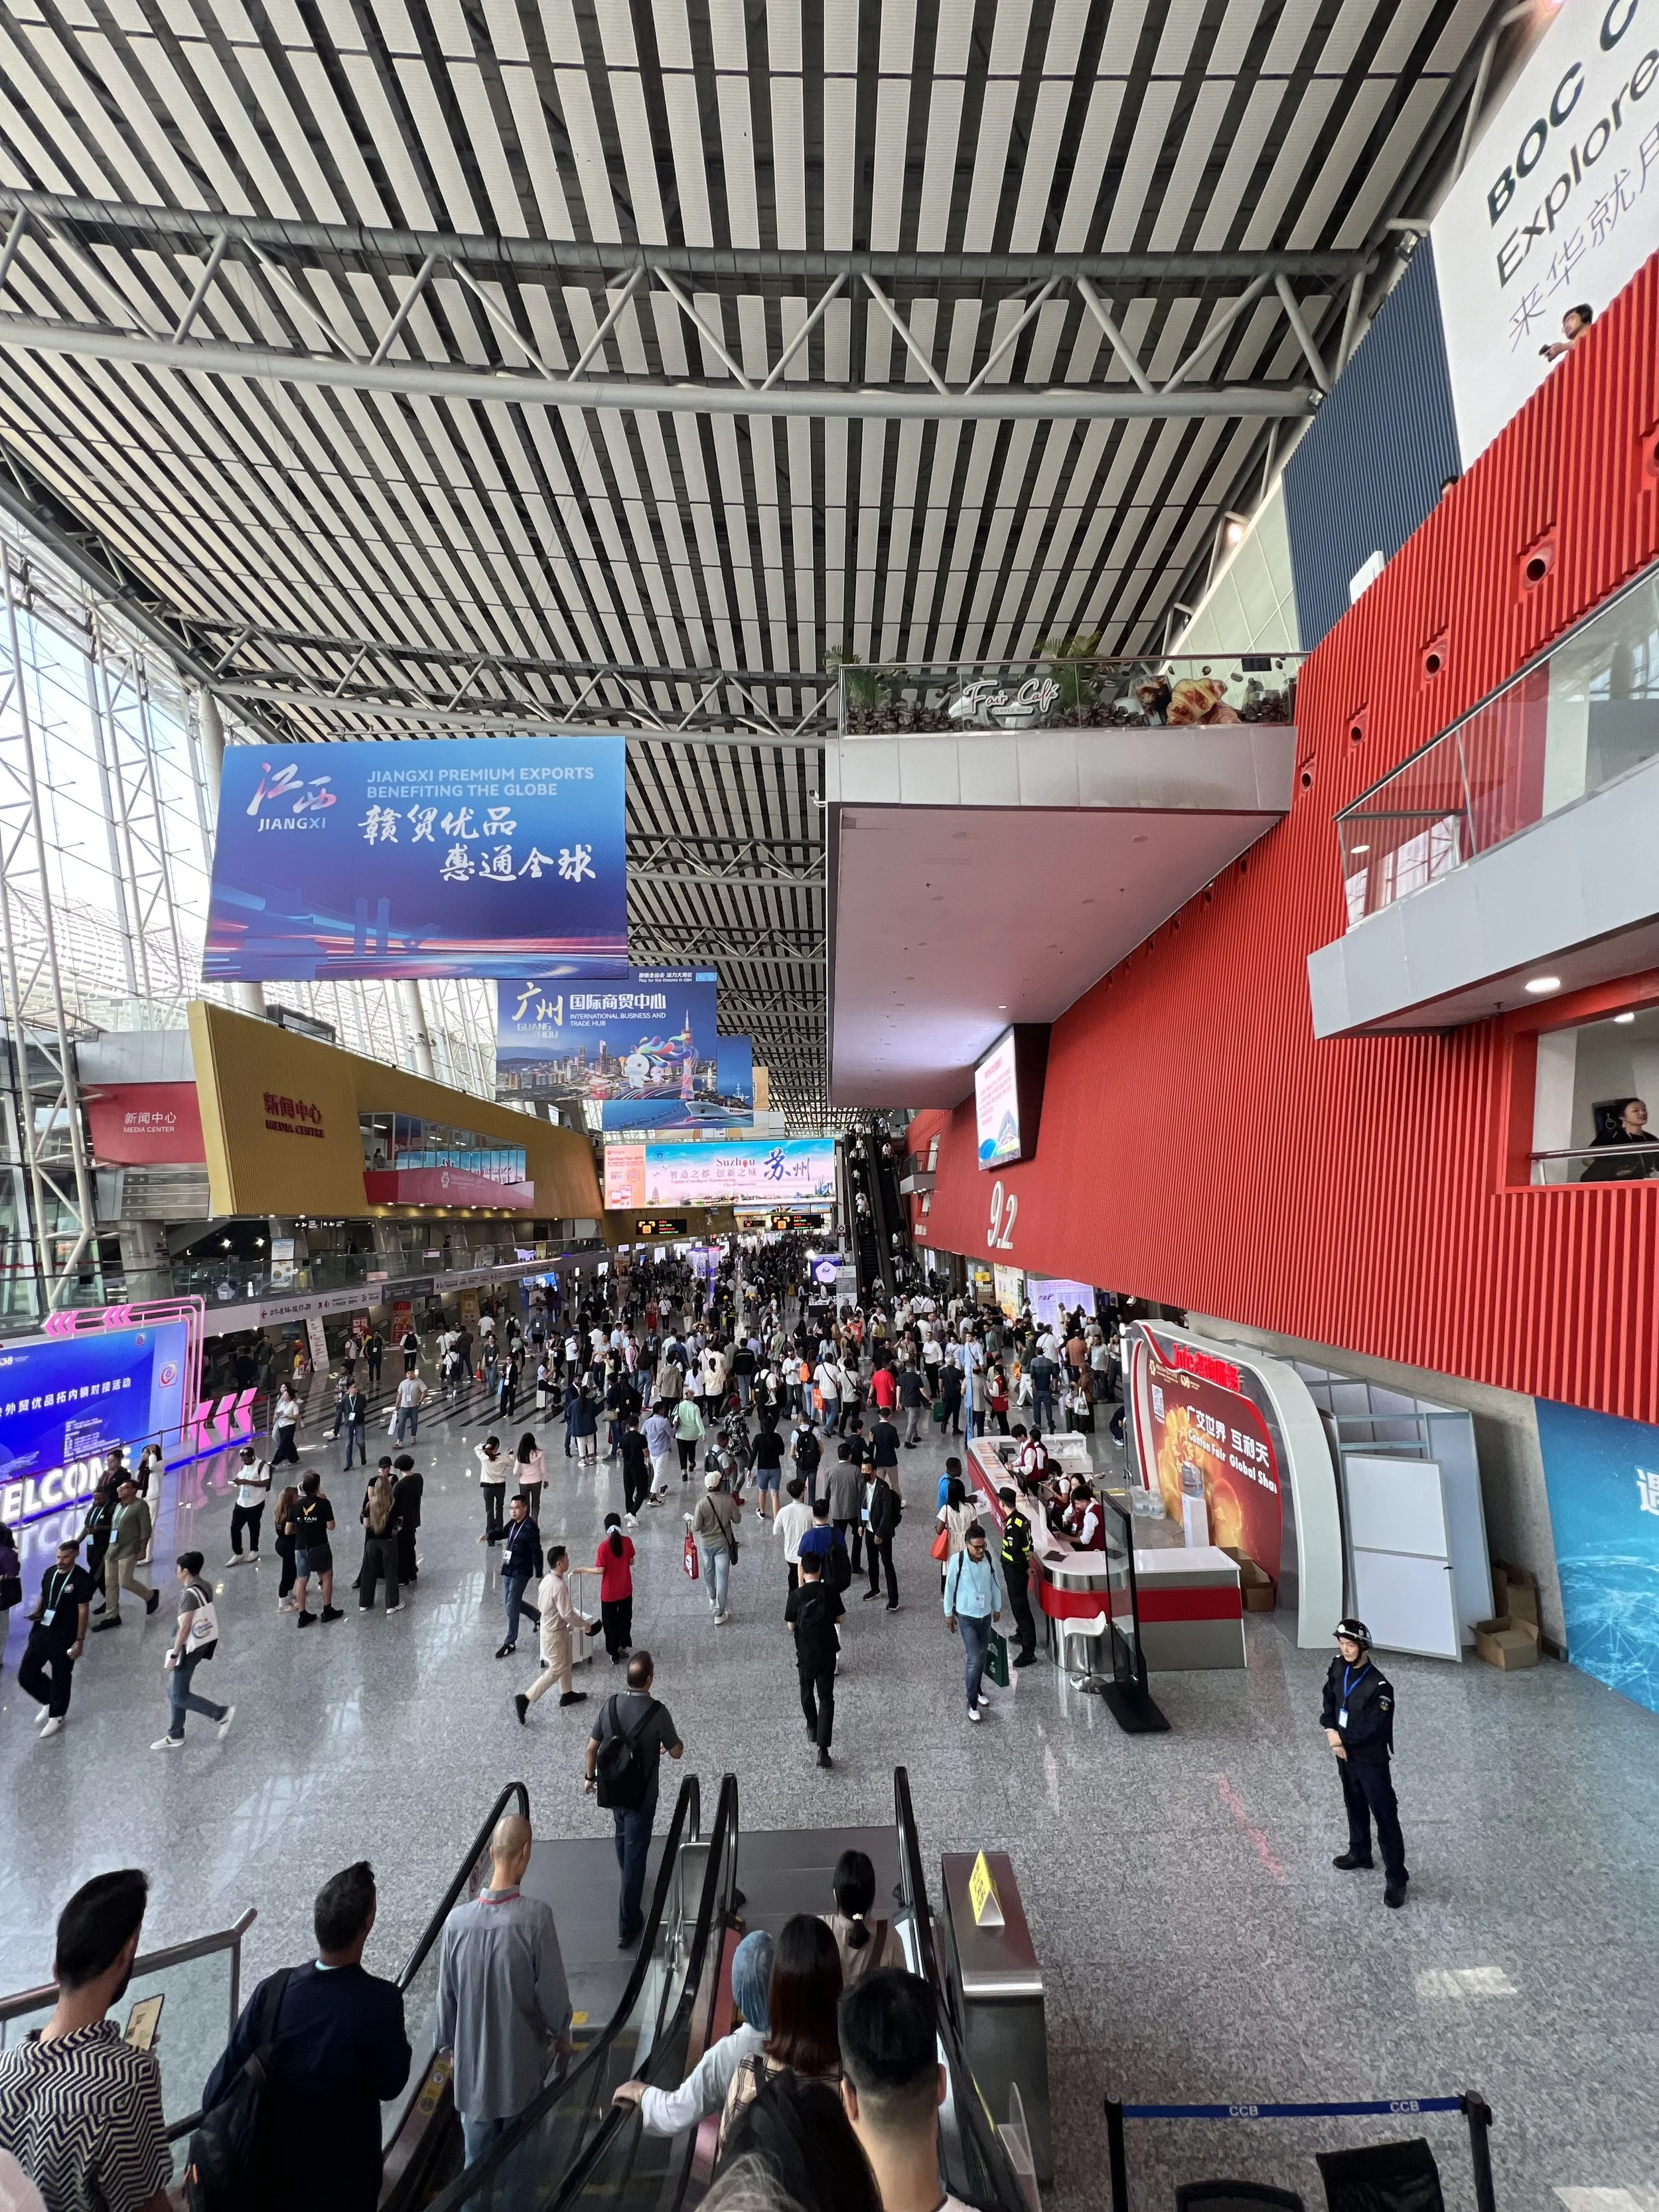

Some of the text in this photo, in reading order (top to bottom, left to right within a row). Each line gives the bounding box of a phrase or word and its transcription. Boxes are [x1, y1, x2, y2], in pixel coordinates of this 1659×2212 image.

[1488, 61, 1585, 228] BOC
[1497, 48, 1659, 289] Explore
[963, 680, 1008, 714] Fair
[246, 762, 337, 816] 江西
[366, 766, 595, 784] JIANGXI PREMIUM EXPORTS
[367, 782, 558, 798] BENEFITING THE GLOBE
[257, 817, 326, 832] JIANGXI
[357, 804, 518, 845] 赣贸优品
[439, 842, 597, 883] 惠通全球
[512, 982, 563, 1026] 广州
[569, 993, 666, 1011] 国际商贸中心
[517, 1023, 552, 1031] GUANG
[124, 1112, 177, 1124] 新闻中心
[263, 1092, 322, 1124] 新闻中心
[265, 1120, 294, 1133] MEDIA
[670, 1168, 756, 1179] 智造之都 创新之城
[716, 1157, 755, 1167] Suzhou
[764, 1146, 811, 1181] 苏州
[1187, 1405, 1226, 1443] 广交世界
[1188, 1429, 1211, 1453] Canton
[1212, 1443, 1226, 1461] Fair
[1230, 1453, 1256, 1481] Global
[1230, 1428, 1269, 1468] 互利天
[1229, 2104, 1259, 2117] CCB
[1390, 2100, 1419, 2113] CCB
